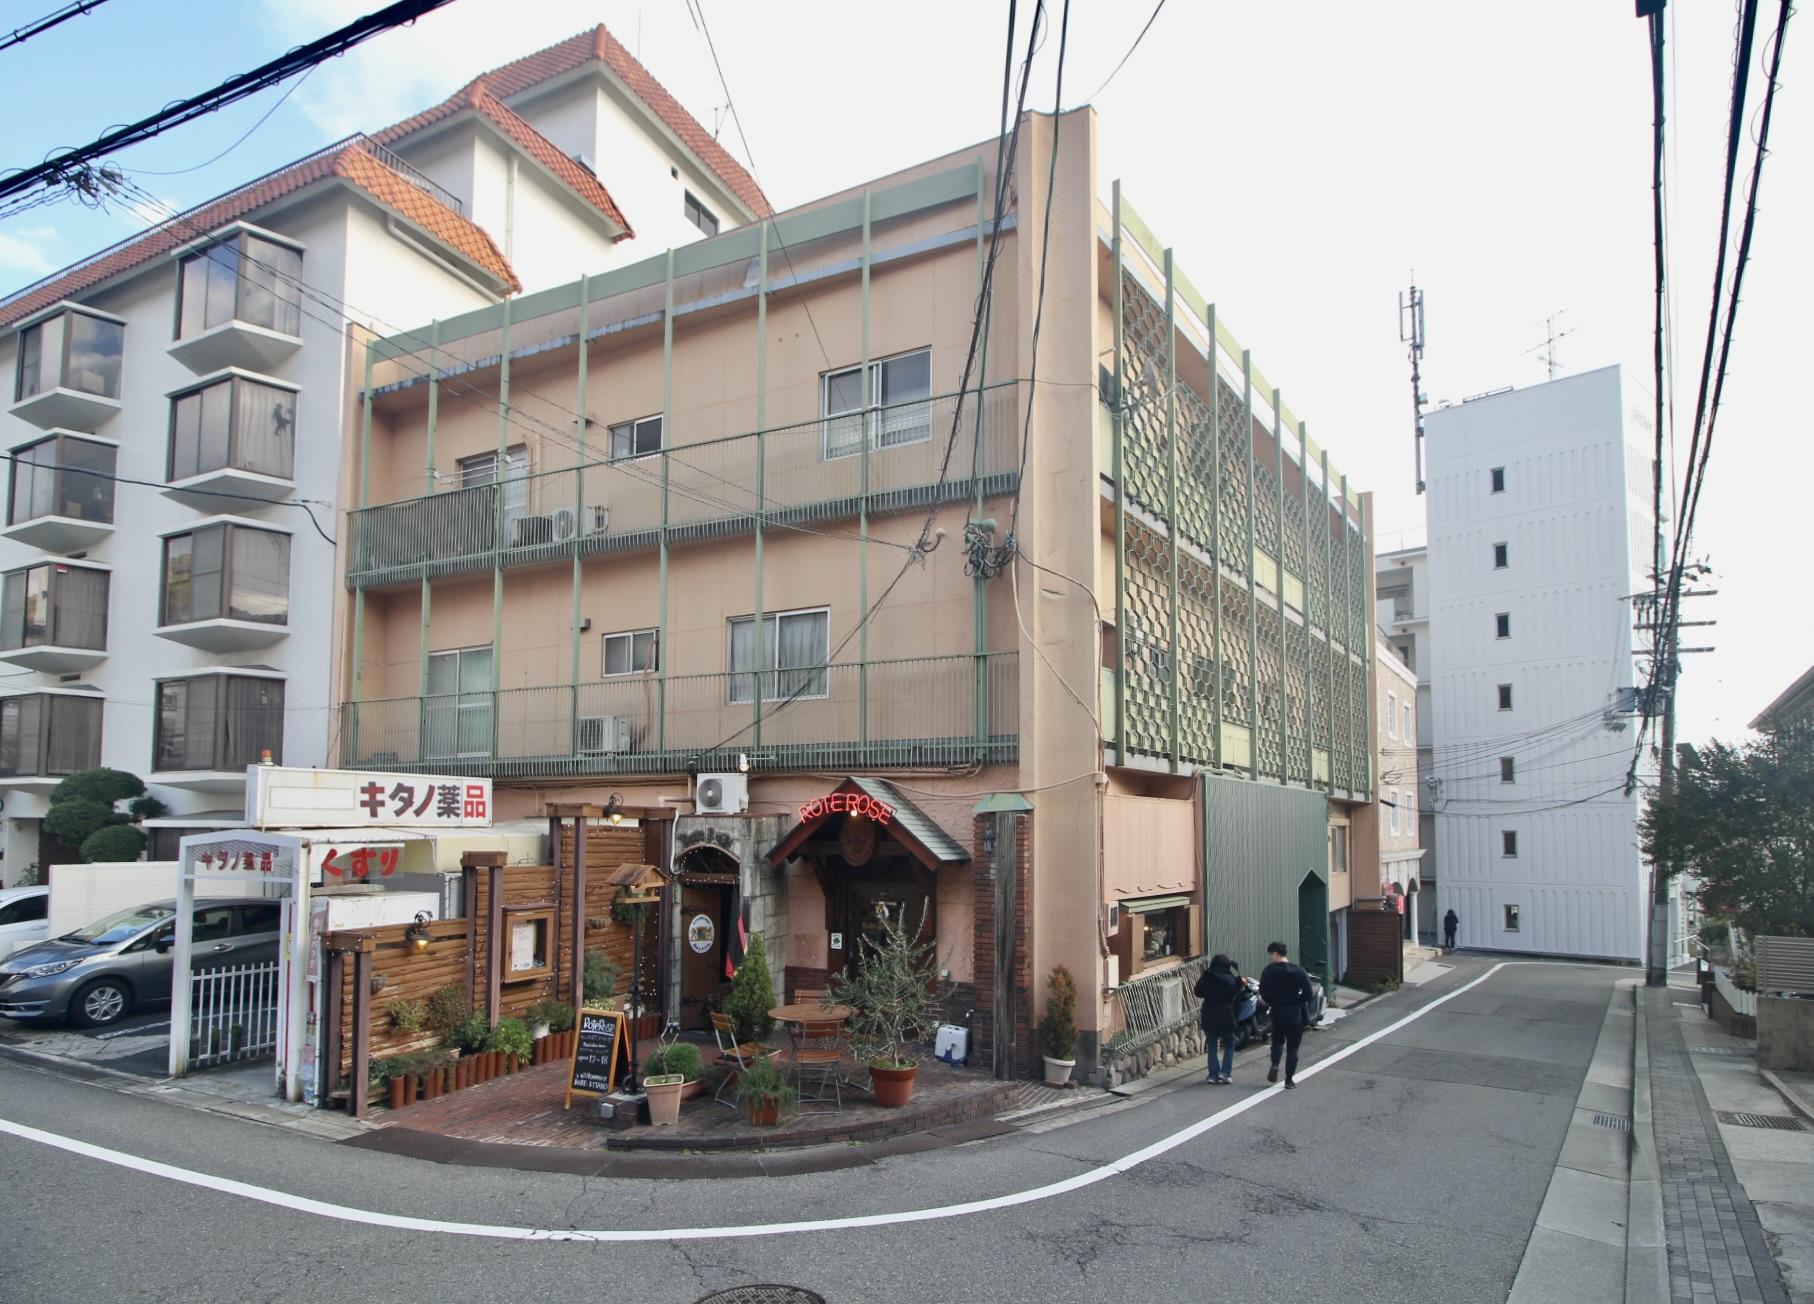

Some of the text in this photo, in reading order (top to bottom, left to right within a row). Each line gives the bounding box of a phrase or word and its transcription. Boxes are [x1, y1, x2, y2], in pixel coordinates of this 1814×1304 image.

[360, 781, 486, 818] キタノ薬品
[799, 793, 896, 824] ROTE ROSE
[200, 851, 273, 872] キタノ薬品
[321, 848, 399, 878] くすり
